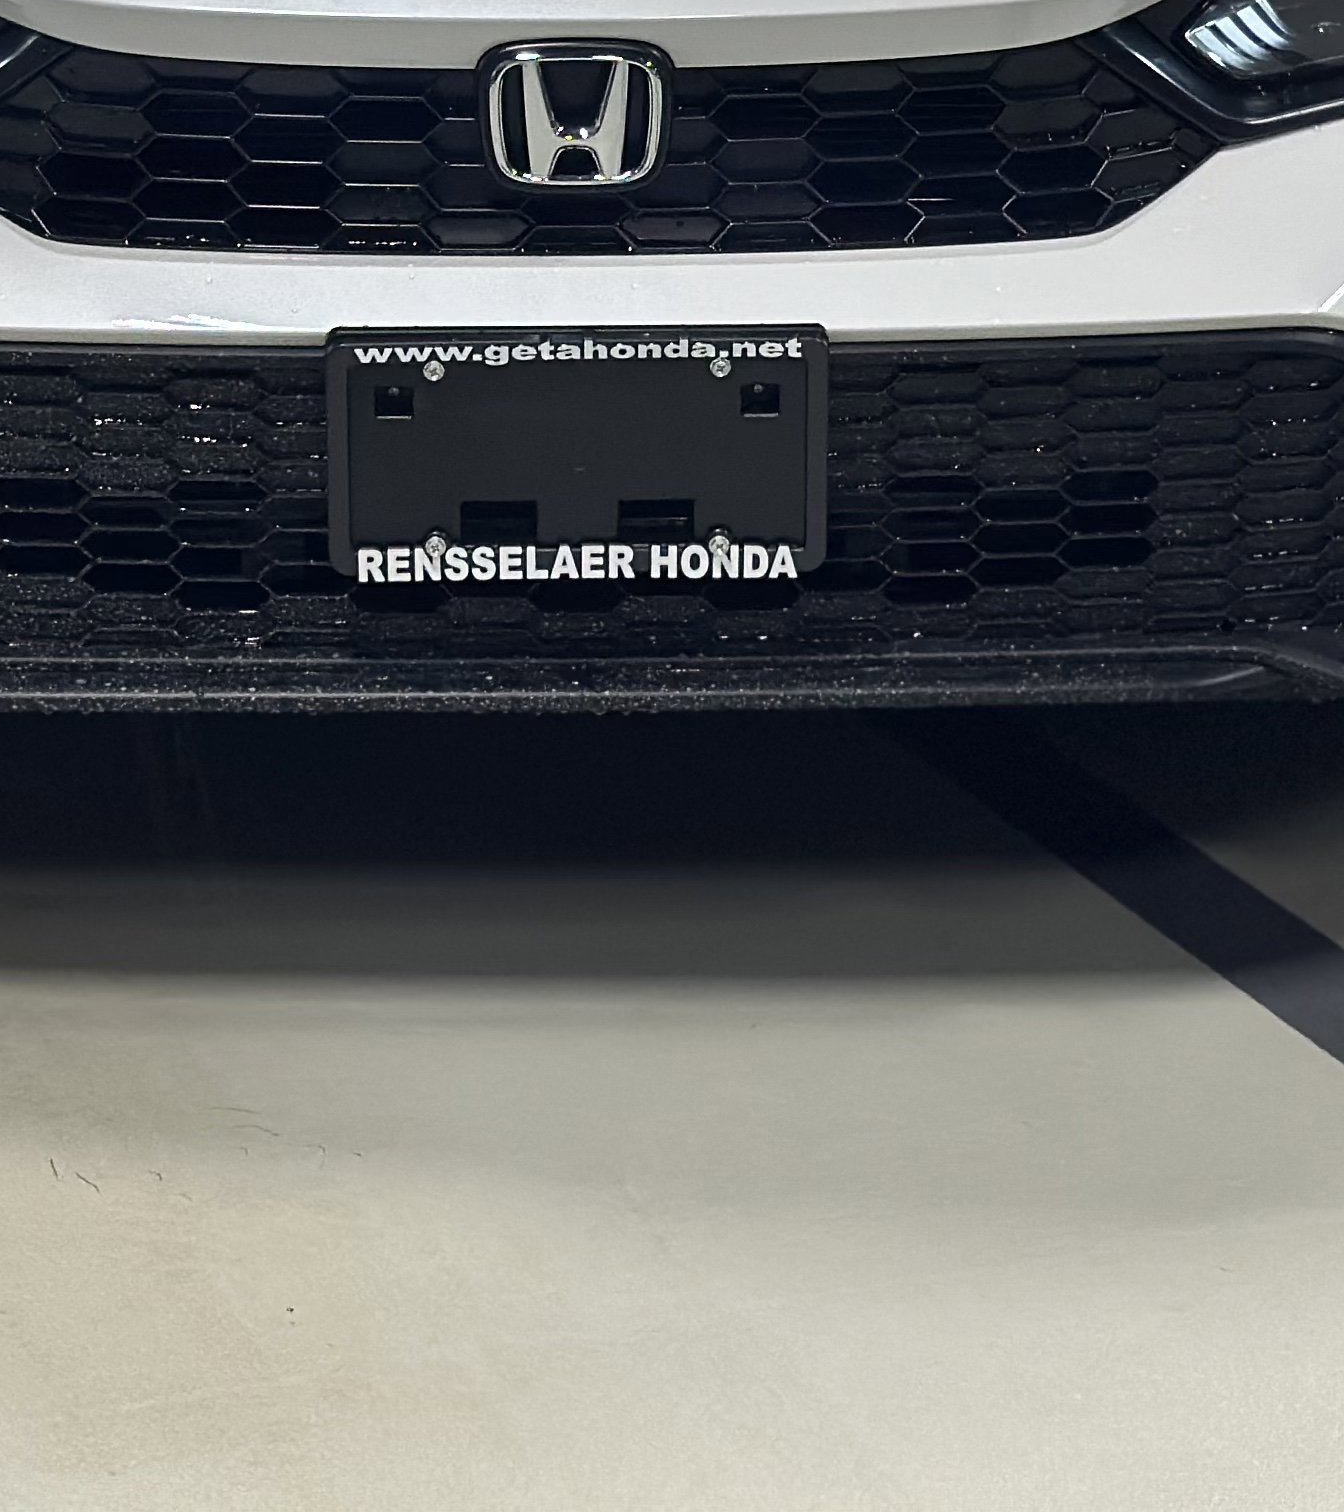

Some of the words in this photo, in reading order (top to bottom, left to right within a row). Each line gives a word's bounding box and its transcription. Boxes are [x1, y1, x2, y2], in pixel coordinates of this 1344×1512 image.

[354, 337, 802, 366] www.getahonda.net
[357, 545, 636, 582] RENSSELAER
[650, 544, 798, 579] HONDA
